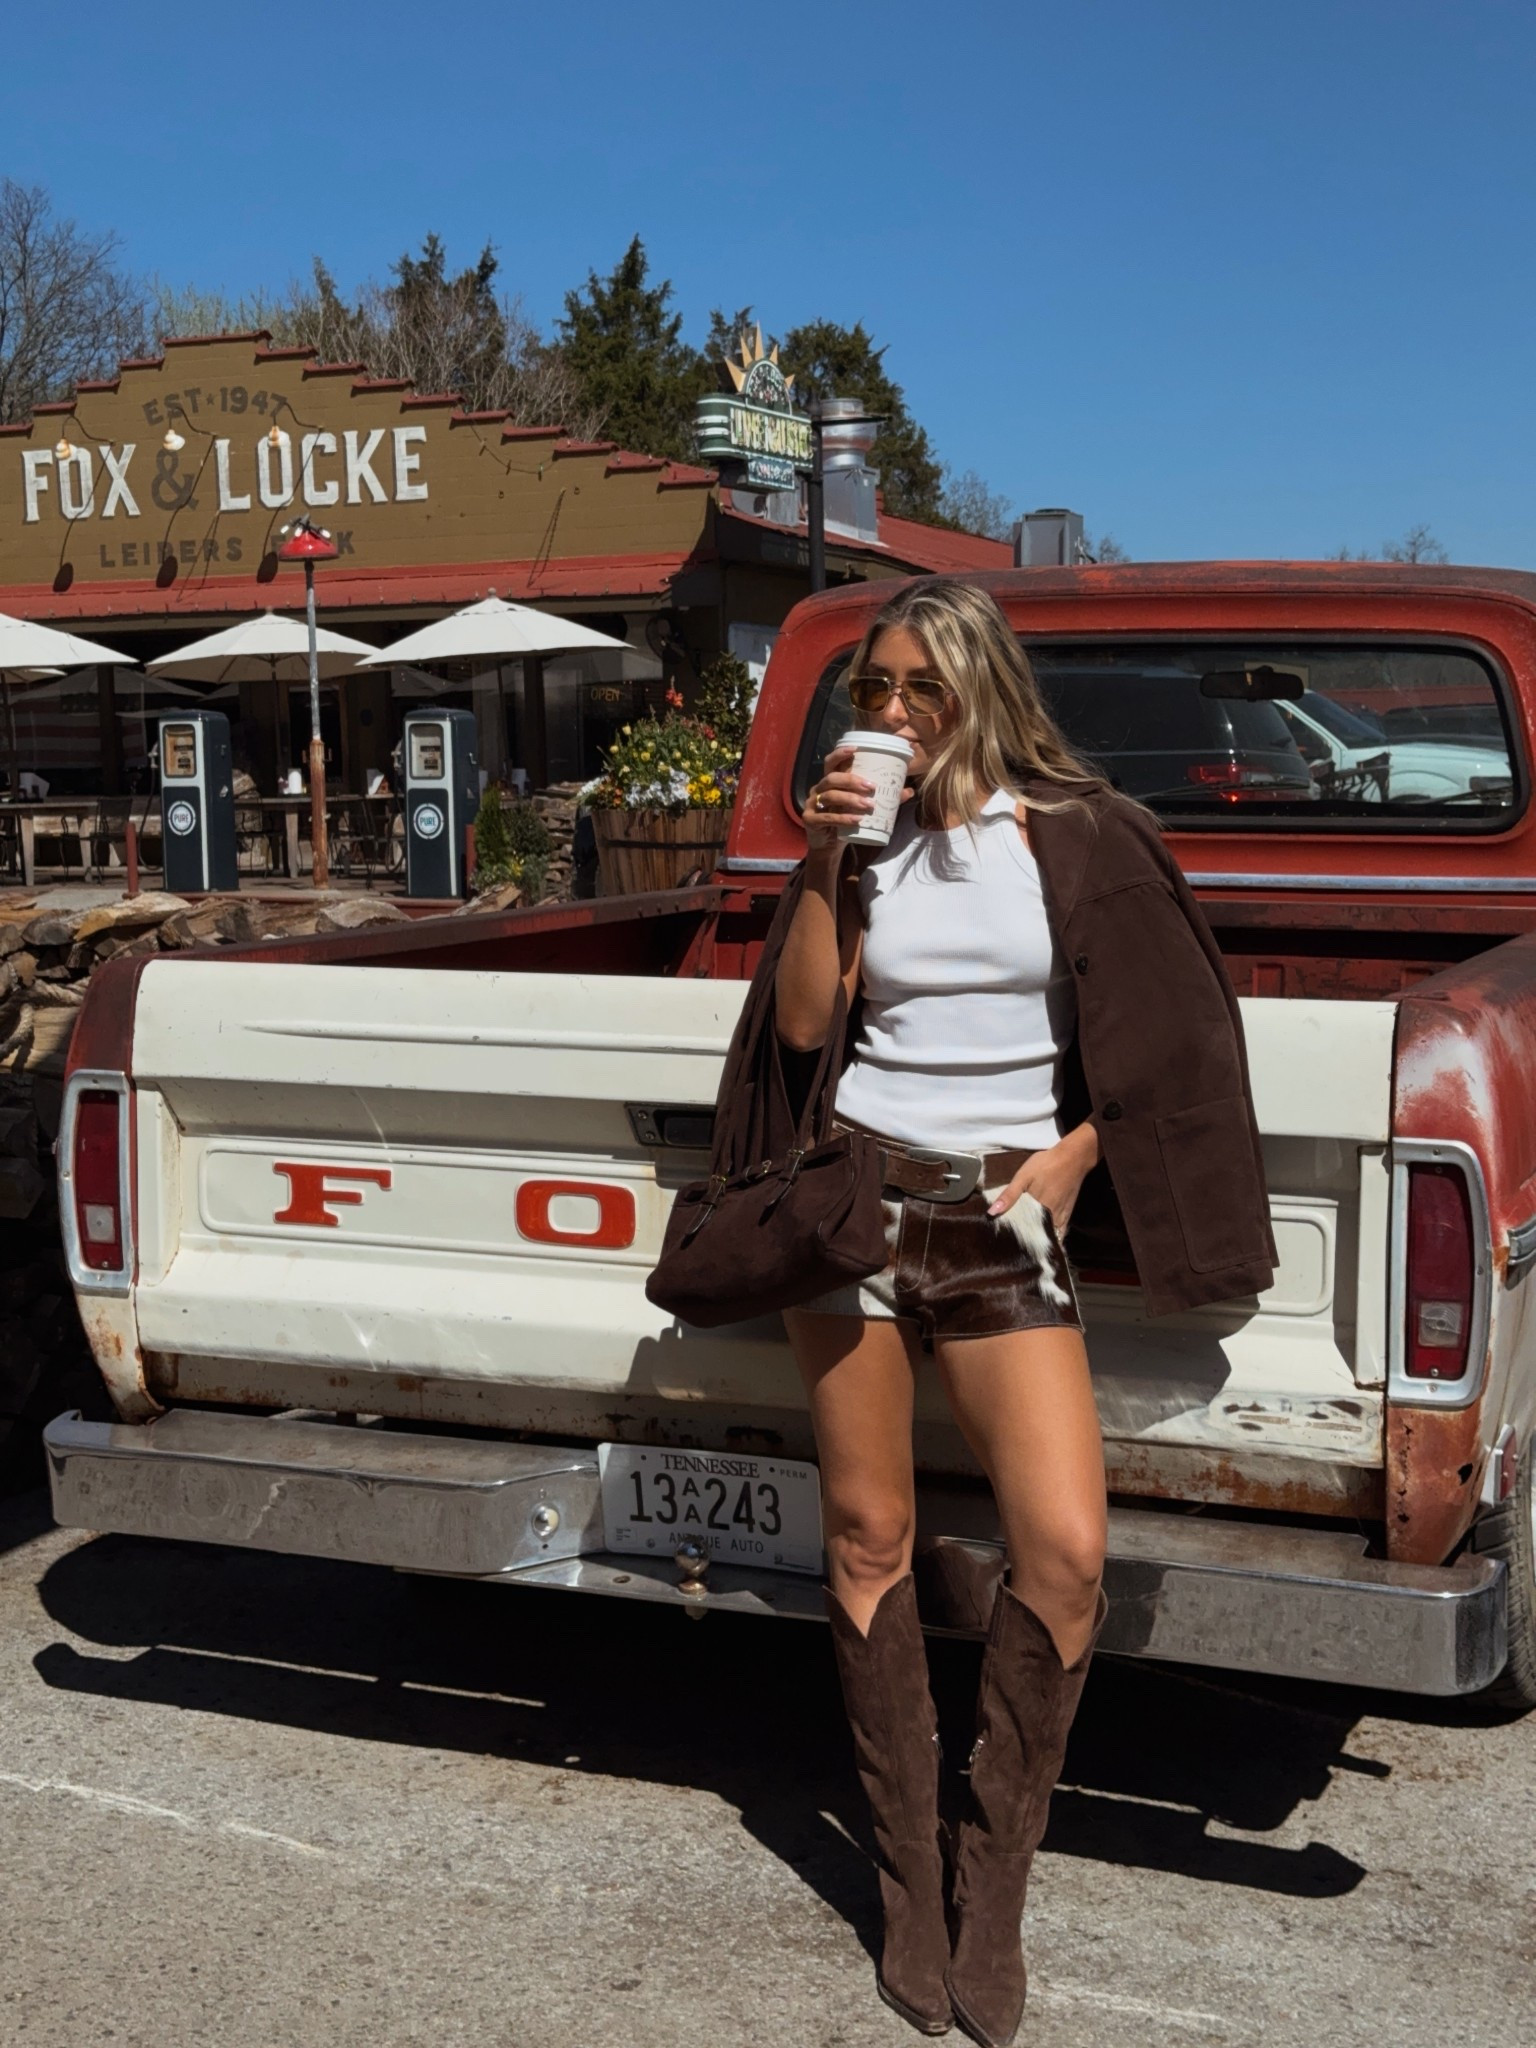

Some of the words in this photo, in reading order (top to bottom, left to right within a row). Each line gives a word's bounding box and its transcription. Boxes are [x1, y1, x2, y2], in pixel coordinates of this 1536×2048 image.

[142, 387, 201, 426] EST
[219, 386, 288, 418] 1947
[21, 443, 141, 522] FOX
[151, 447, 198, 512] &
[215, 426, 429, 512] LOCKE
[591, 686, 621, 701] OPEN
[174, 813, 189, 823] PURE
[420, 816, 436, 827] PURE
[661, 1453, 760, 1478] TENNESSEE
[780, 1468, 808, 1480] PERM
[730, 1538, 764, 1554] AUTO
